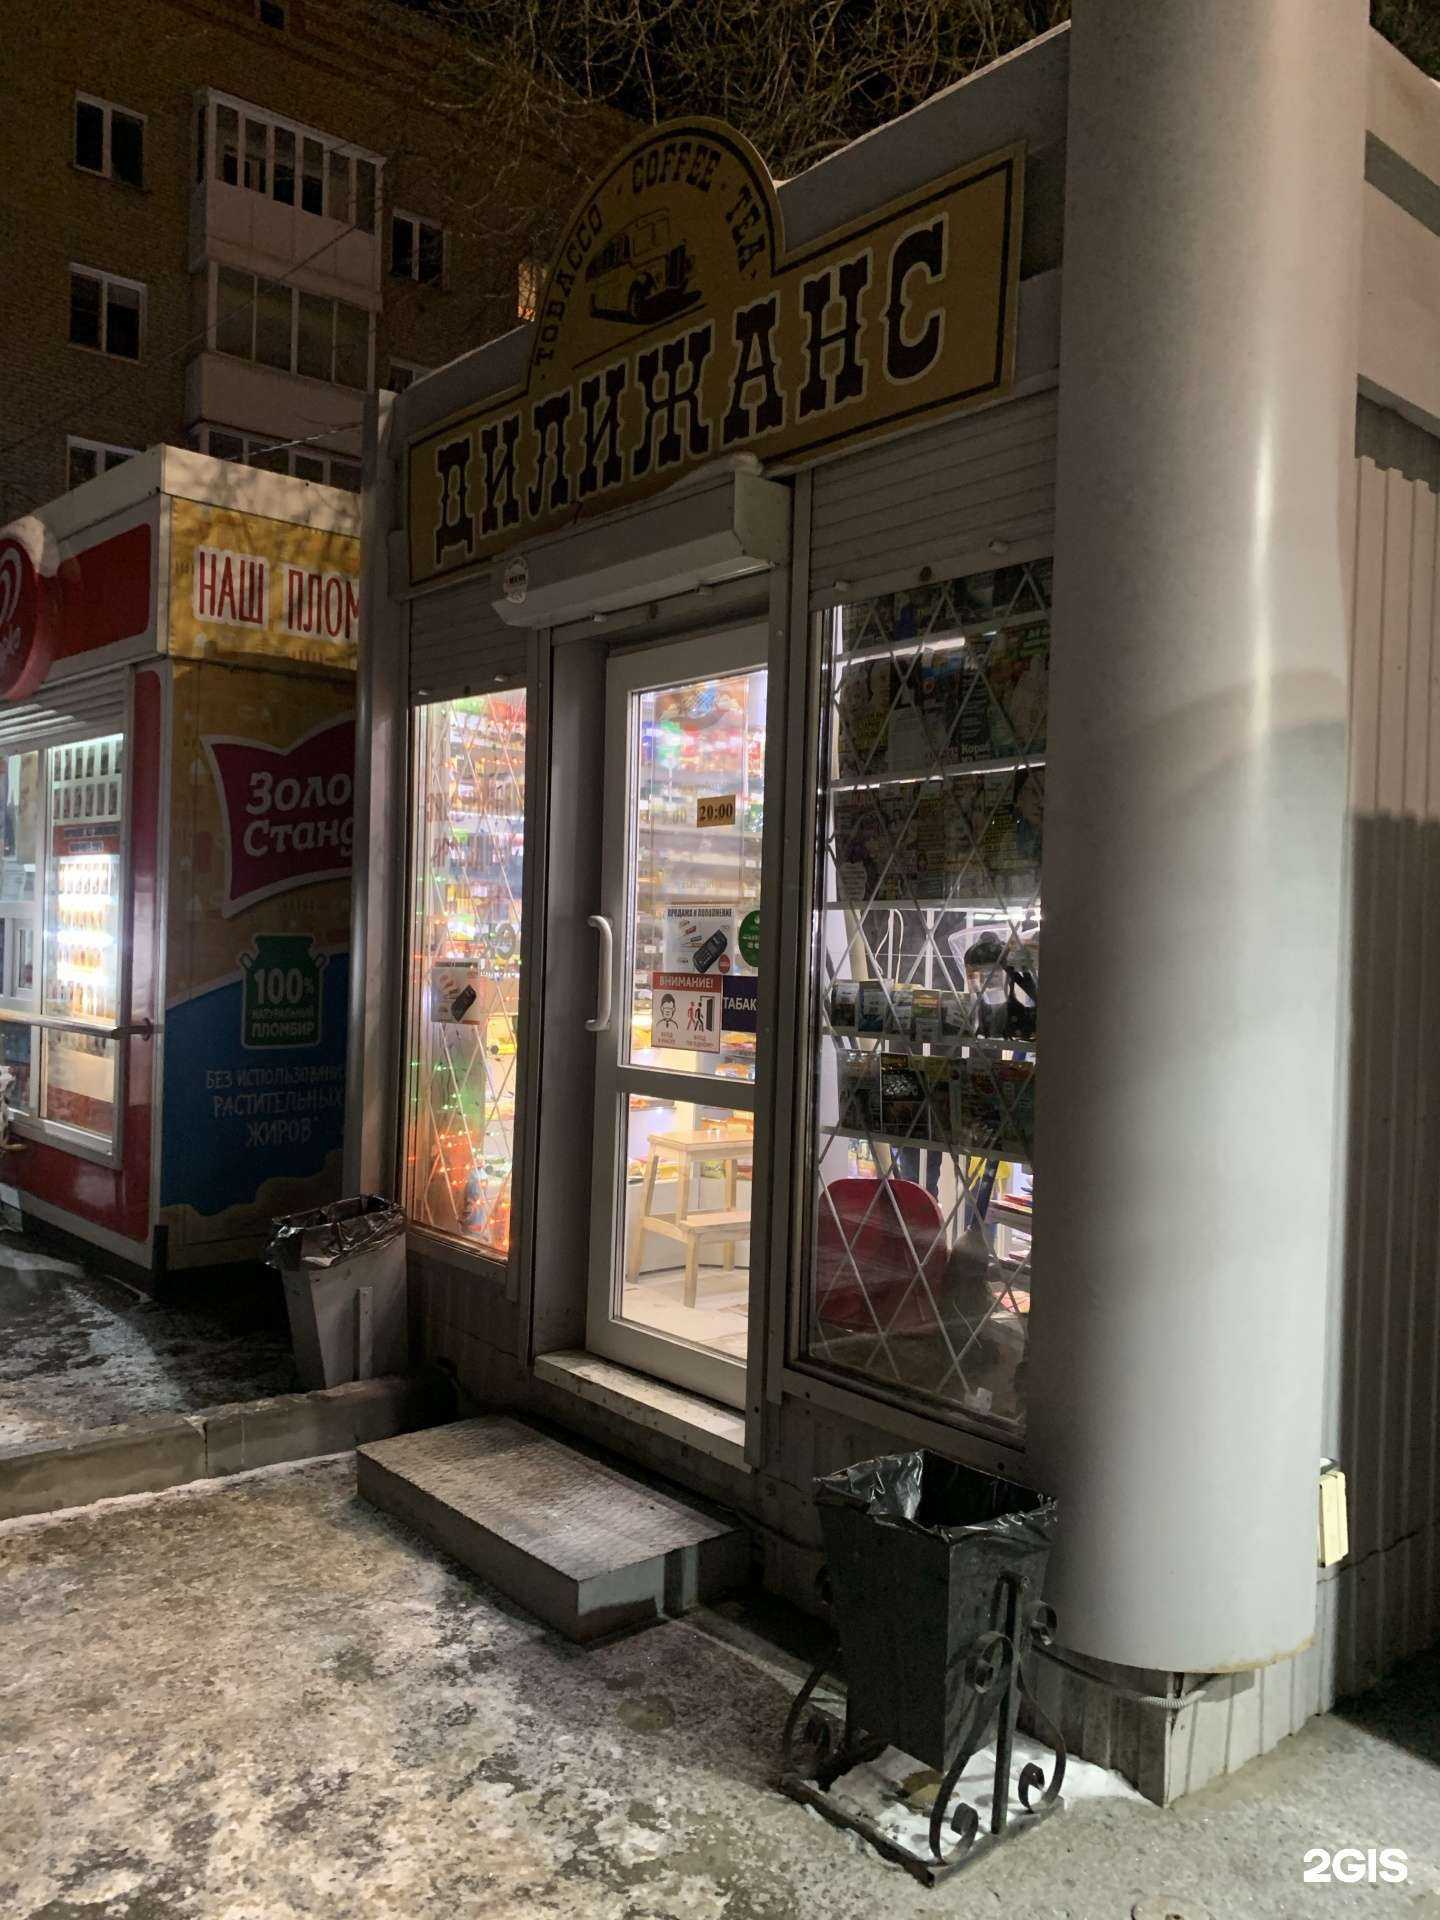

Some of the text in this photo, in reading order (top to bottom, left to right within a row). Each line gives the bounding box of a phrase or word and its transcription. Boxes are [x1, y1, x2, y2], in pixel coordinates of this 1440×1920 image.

[535, 141, 766, 366] TOBACCO COFFEE TEA
[434, 212, 949, 571] ДИЛИЖАНС
[199, 550, 264, 625] НАШ
[245, 771, 353, 816] Золо
[698, 803, 733, 821] 20:00
[253, 967, 314, 1005] 100%
[659, 975, 713, 988] ВНИМАНИЕ!
[723, 996, 758, 1011] ТАБАК
[251, 1021, 315, 1039] ПЛОМБИР
[206, 1070, 233, 1089] БЕЗ
